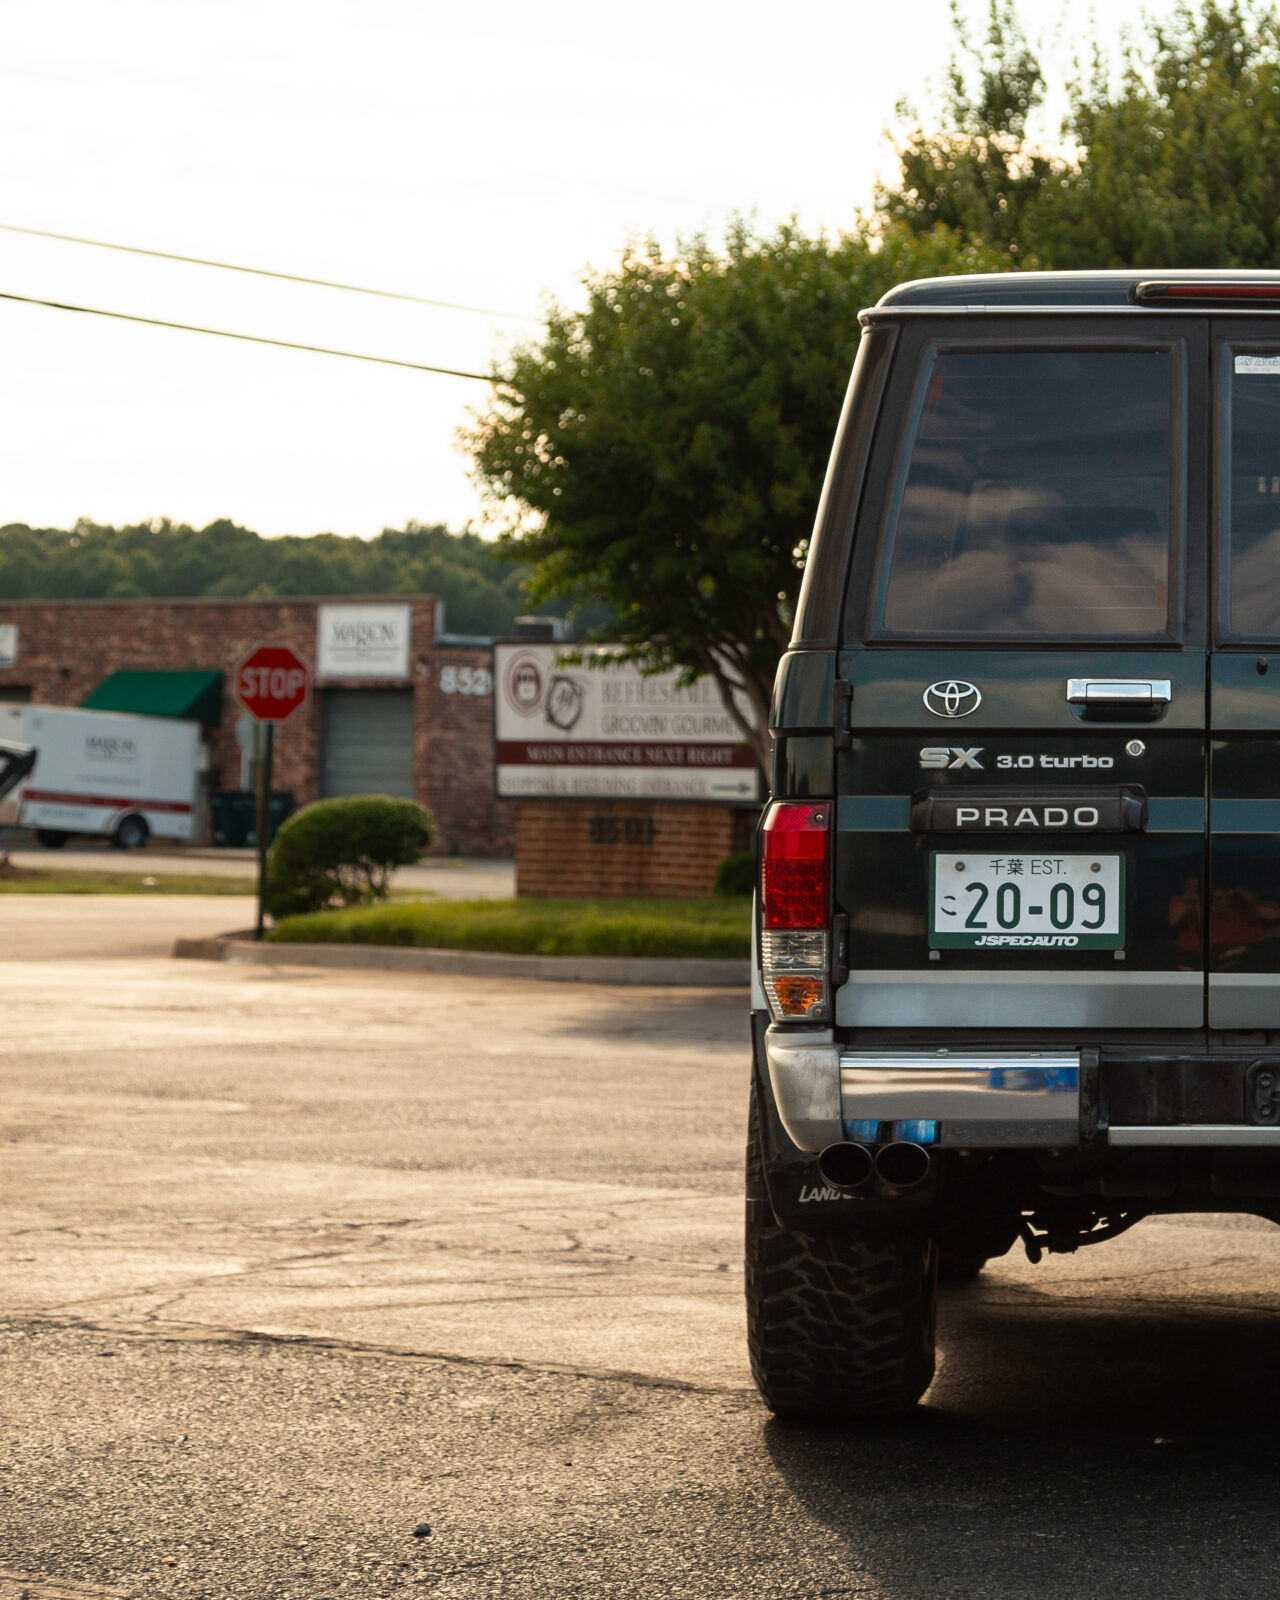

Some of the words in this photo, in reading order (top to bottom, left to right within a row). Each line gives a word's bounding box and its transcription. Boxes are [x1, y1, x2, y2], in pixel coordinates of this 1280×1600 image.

[240, 667, 304, 699] STOP
[526, 746, 564, 762] MAIN
[567, 746, 642, 763] ENTRANCE
[645, 747, 685, 764] NEXT
[687, 747, 733, 764] RIGHT
[920, 748, 984, 769] SX
[997, 755, 1034, 768] 3.0
[1040, 754, 1114, 769] turbo
[500, 776, 553, 792] SHIPPING
[640, 778, 707, 795] ENTRANCE
[956, 807, 1099, 827] PRADO
[989, 858, 1024, 876] 千葉
[1031, 859, 1067, 875] EST.
[940, 895, 957, 916] こ
[964, 881, 1106, 930] 20-09
